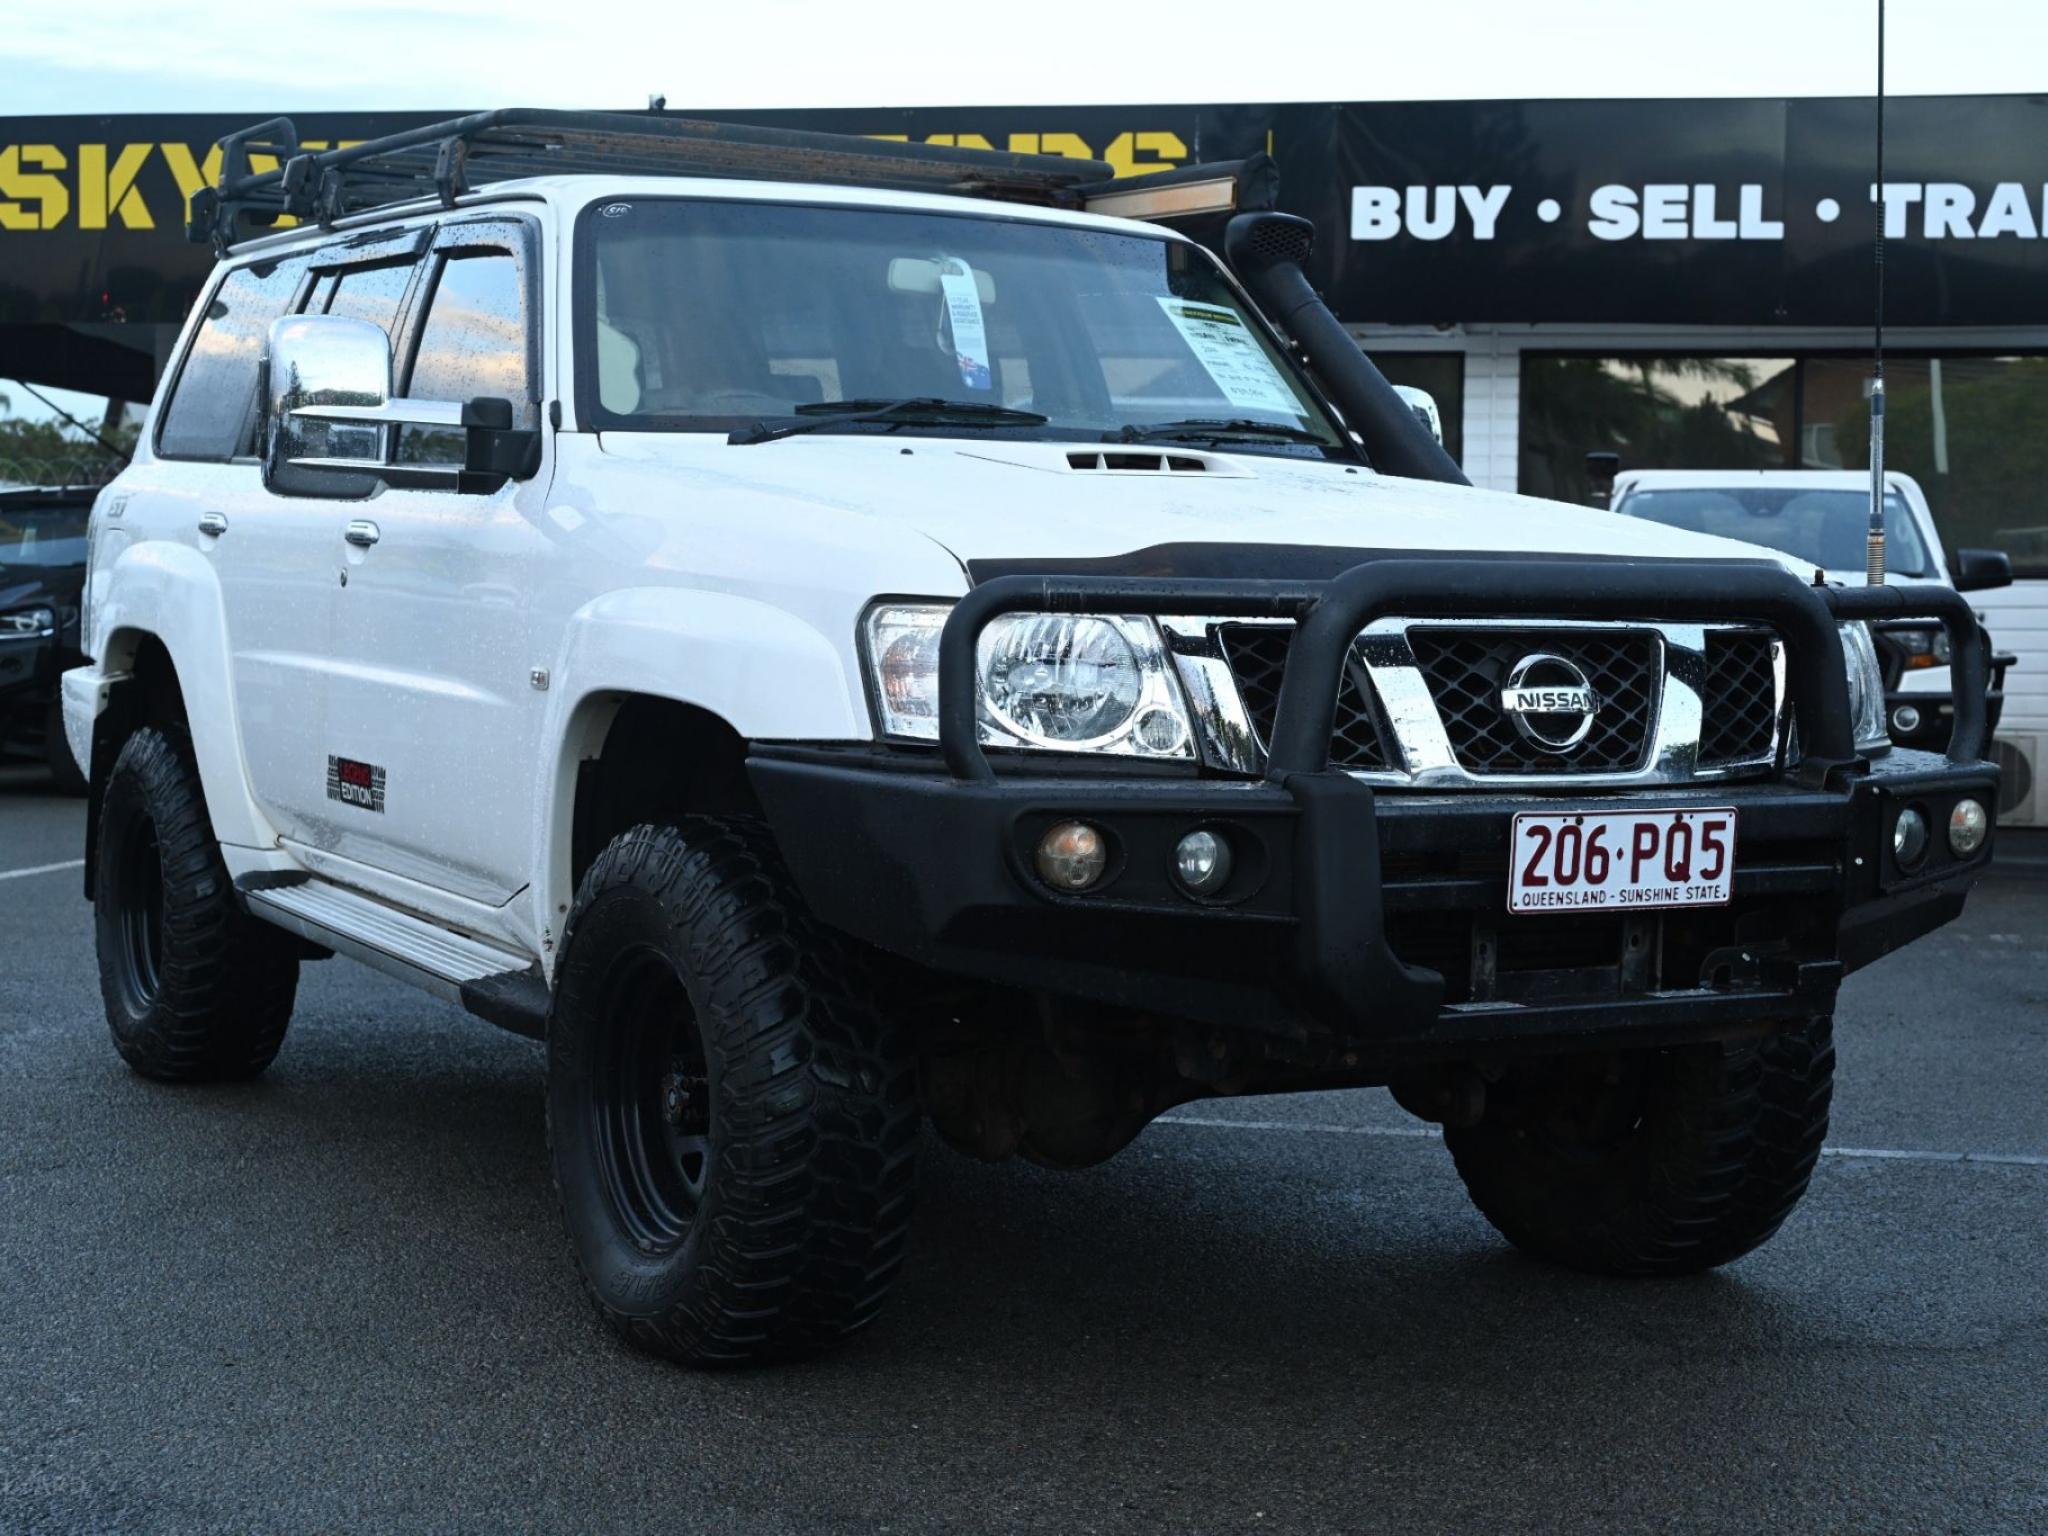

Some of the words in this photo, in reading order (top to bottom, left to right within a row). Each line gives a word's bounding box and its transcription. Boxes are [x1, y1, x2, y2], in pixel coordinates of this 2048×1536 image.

[1351, 185, 1512, 240] BUY
[1588, 184, 1785, 240] SELL
[1870, 182, 2048, 239] TRA
[1517, 692, 1598, 709] NISSAN
[341, 782, 373, 806] EDITION
[1523, 891, 1606, 907] QUEENSLAND
[1619, 887, 1680, 904] SUNSHINE
[1686, 884, 1721, 900] STATE
